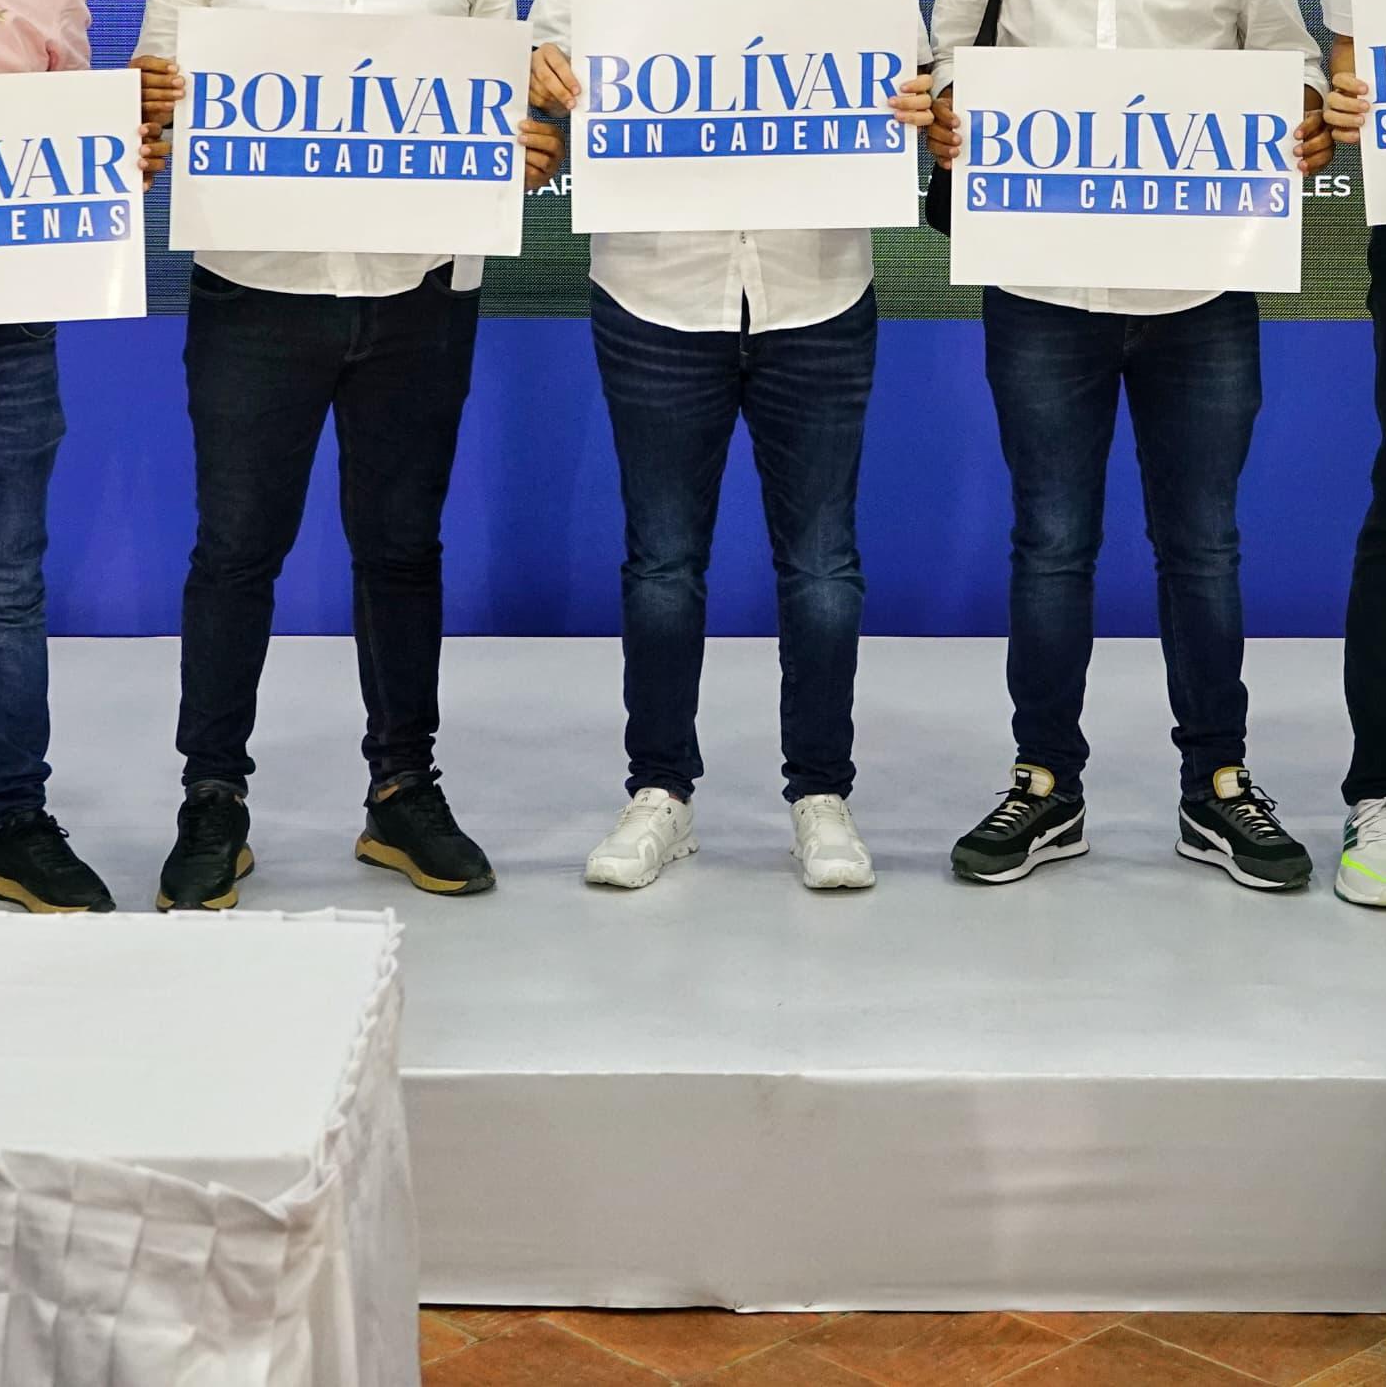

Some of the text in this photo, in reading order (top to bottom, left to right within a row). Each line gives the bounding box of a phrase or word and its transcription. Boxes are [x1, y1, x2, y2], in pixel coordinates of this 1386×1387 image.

[187, 58, 514, 137] BOLÍVAR
[585, 36, 903, 113] BOLÍVAR
[194, 141, 509, 176] SIN CADENAS
[592, 119, 901, 153] SIN CADENAS
[965, 94, 1292, 172] BOLÍVAR
[972, 177, 1042, 207] SIN
[1080, 179, 1286, 213] CADENAS
